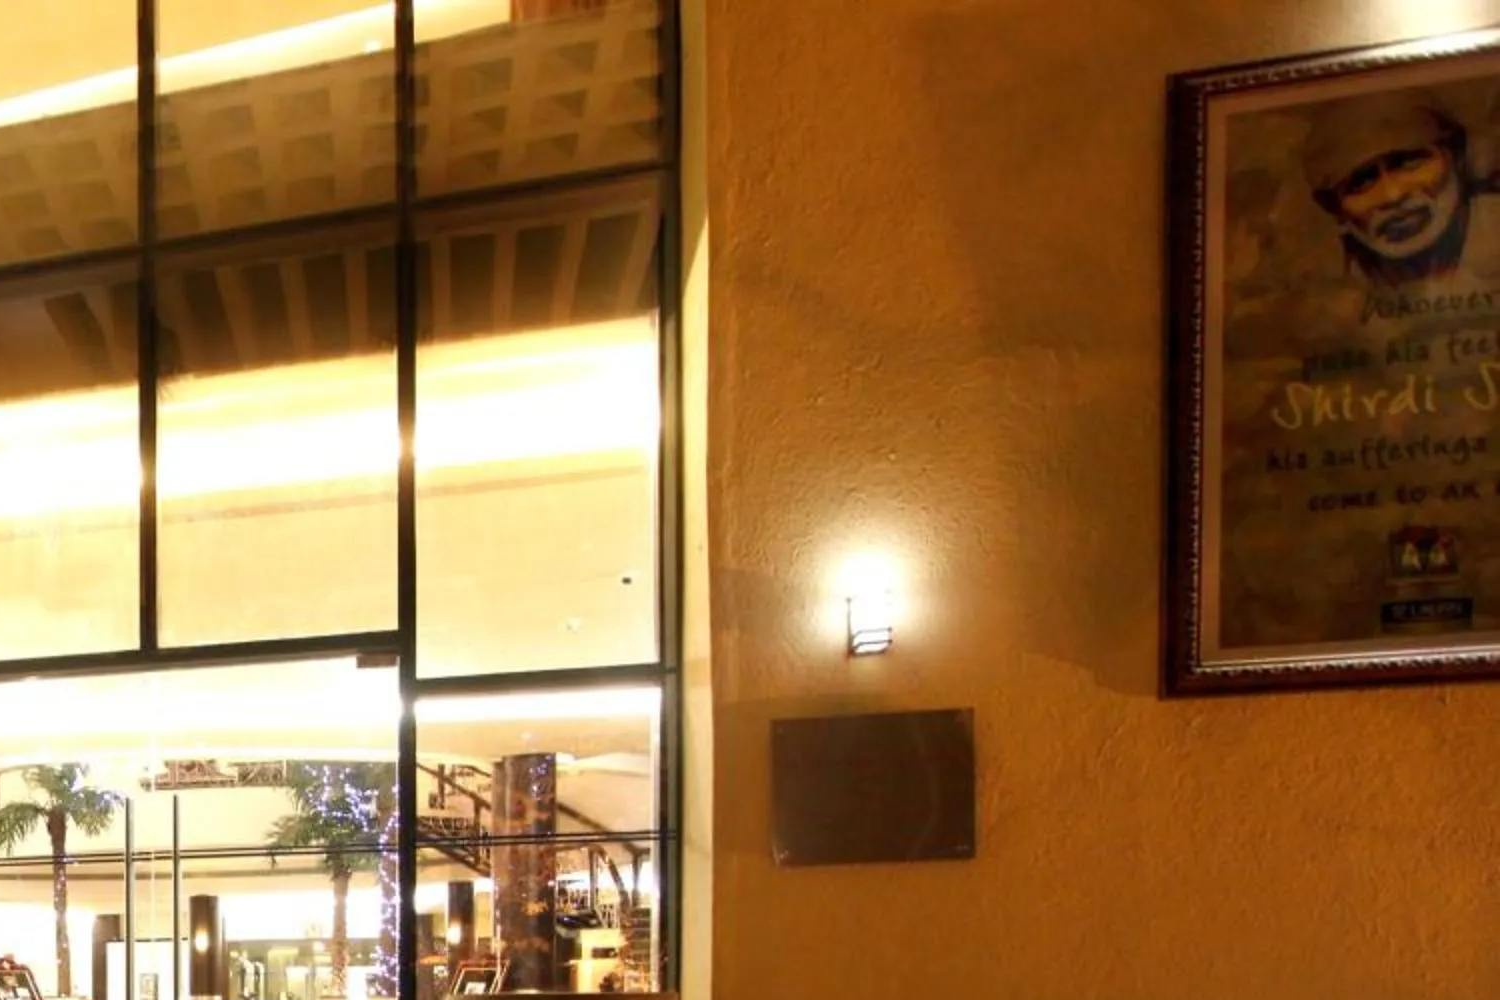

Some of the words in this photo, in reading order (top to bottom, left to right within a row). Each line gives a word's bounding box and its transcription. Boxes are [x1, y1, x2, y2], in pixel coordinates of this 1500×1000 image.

[1270, 373, 1437, 430] Shirdi
[1321, 433, 1488, 472] sufferings
[1307, 486, 1379, 513] come
[1393, 481, 1429, 505] to
